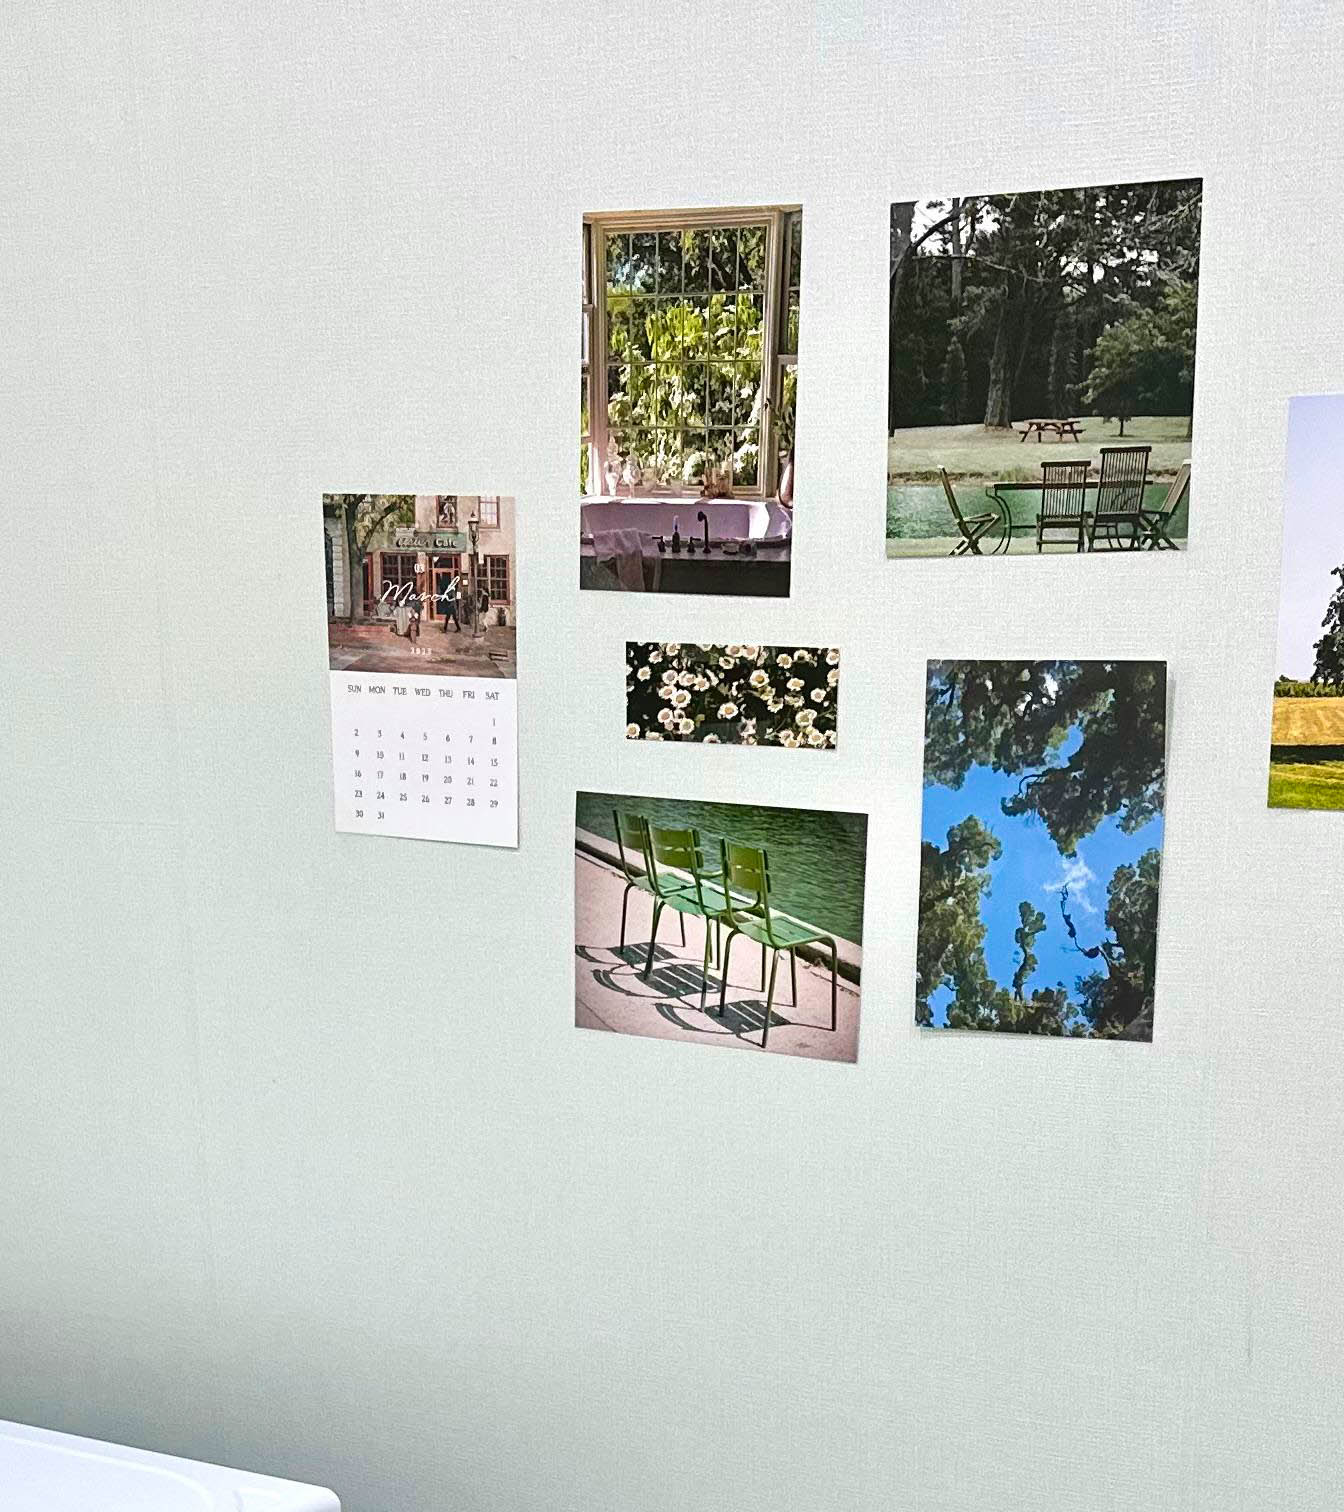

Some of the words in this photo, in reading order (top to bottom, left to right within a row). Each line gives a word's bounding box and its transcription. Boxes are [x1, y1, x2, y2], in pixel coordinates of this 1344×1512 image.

[380, 576, 460, 602] March
[347, 684, 362, 693] SUN
[368, 685, 386, 694] MON
[393, 687, 407, 696] TUE
[414, 688, 431, 697] WED
[439, 689, 453, 698] THU
[463, 691, 475, 699] FRI
[485, 692, 500, 701] SAT
[493, 718, 495, 726] 1
[423, 732, 427, 741] 5
[446, 734, 450, 742] 6
[492, 737, 497, 745] 8
[377, 751, 384, 759] 10
[399, 752, 405, 760] 11
[422, 754, 429, 762] 12
[445, 756, 452, 764] 13
[467, 757, 475, 765] 14
[491, 759, 498, 767] 15
[354, 770, 362, 778] 16
[377, 771, 383, 779] 17
[422, 774, 429, 783] 19
[444, 776, 452, 784] 20
[467, 777, 474, 785] 21
[490, 779, 498, 787] 22
[354, 790, 363, 798] 23
[377, 792, 385, 800] 24
[399, 793, 407, 801] 25
[422, 795, 430, 803] 26
[444, 797, 452, 805] 27
[467, 798, 475, 807] 28
[490, 800, 498, 808] 29
[355, 810, 363, 818] 30
[377, 811, 385, 819] 31
